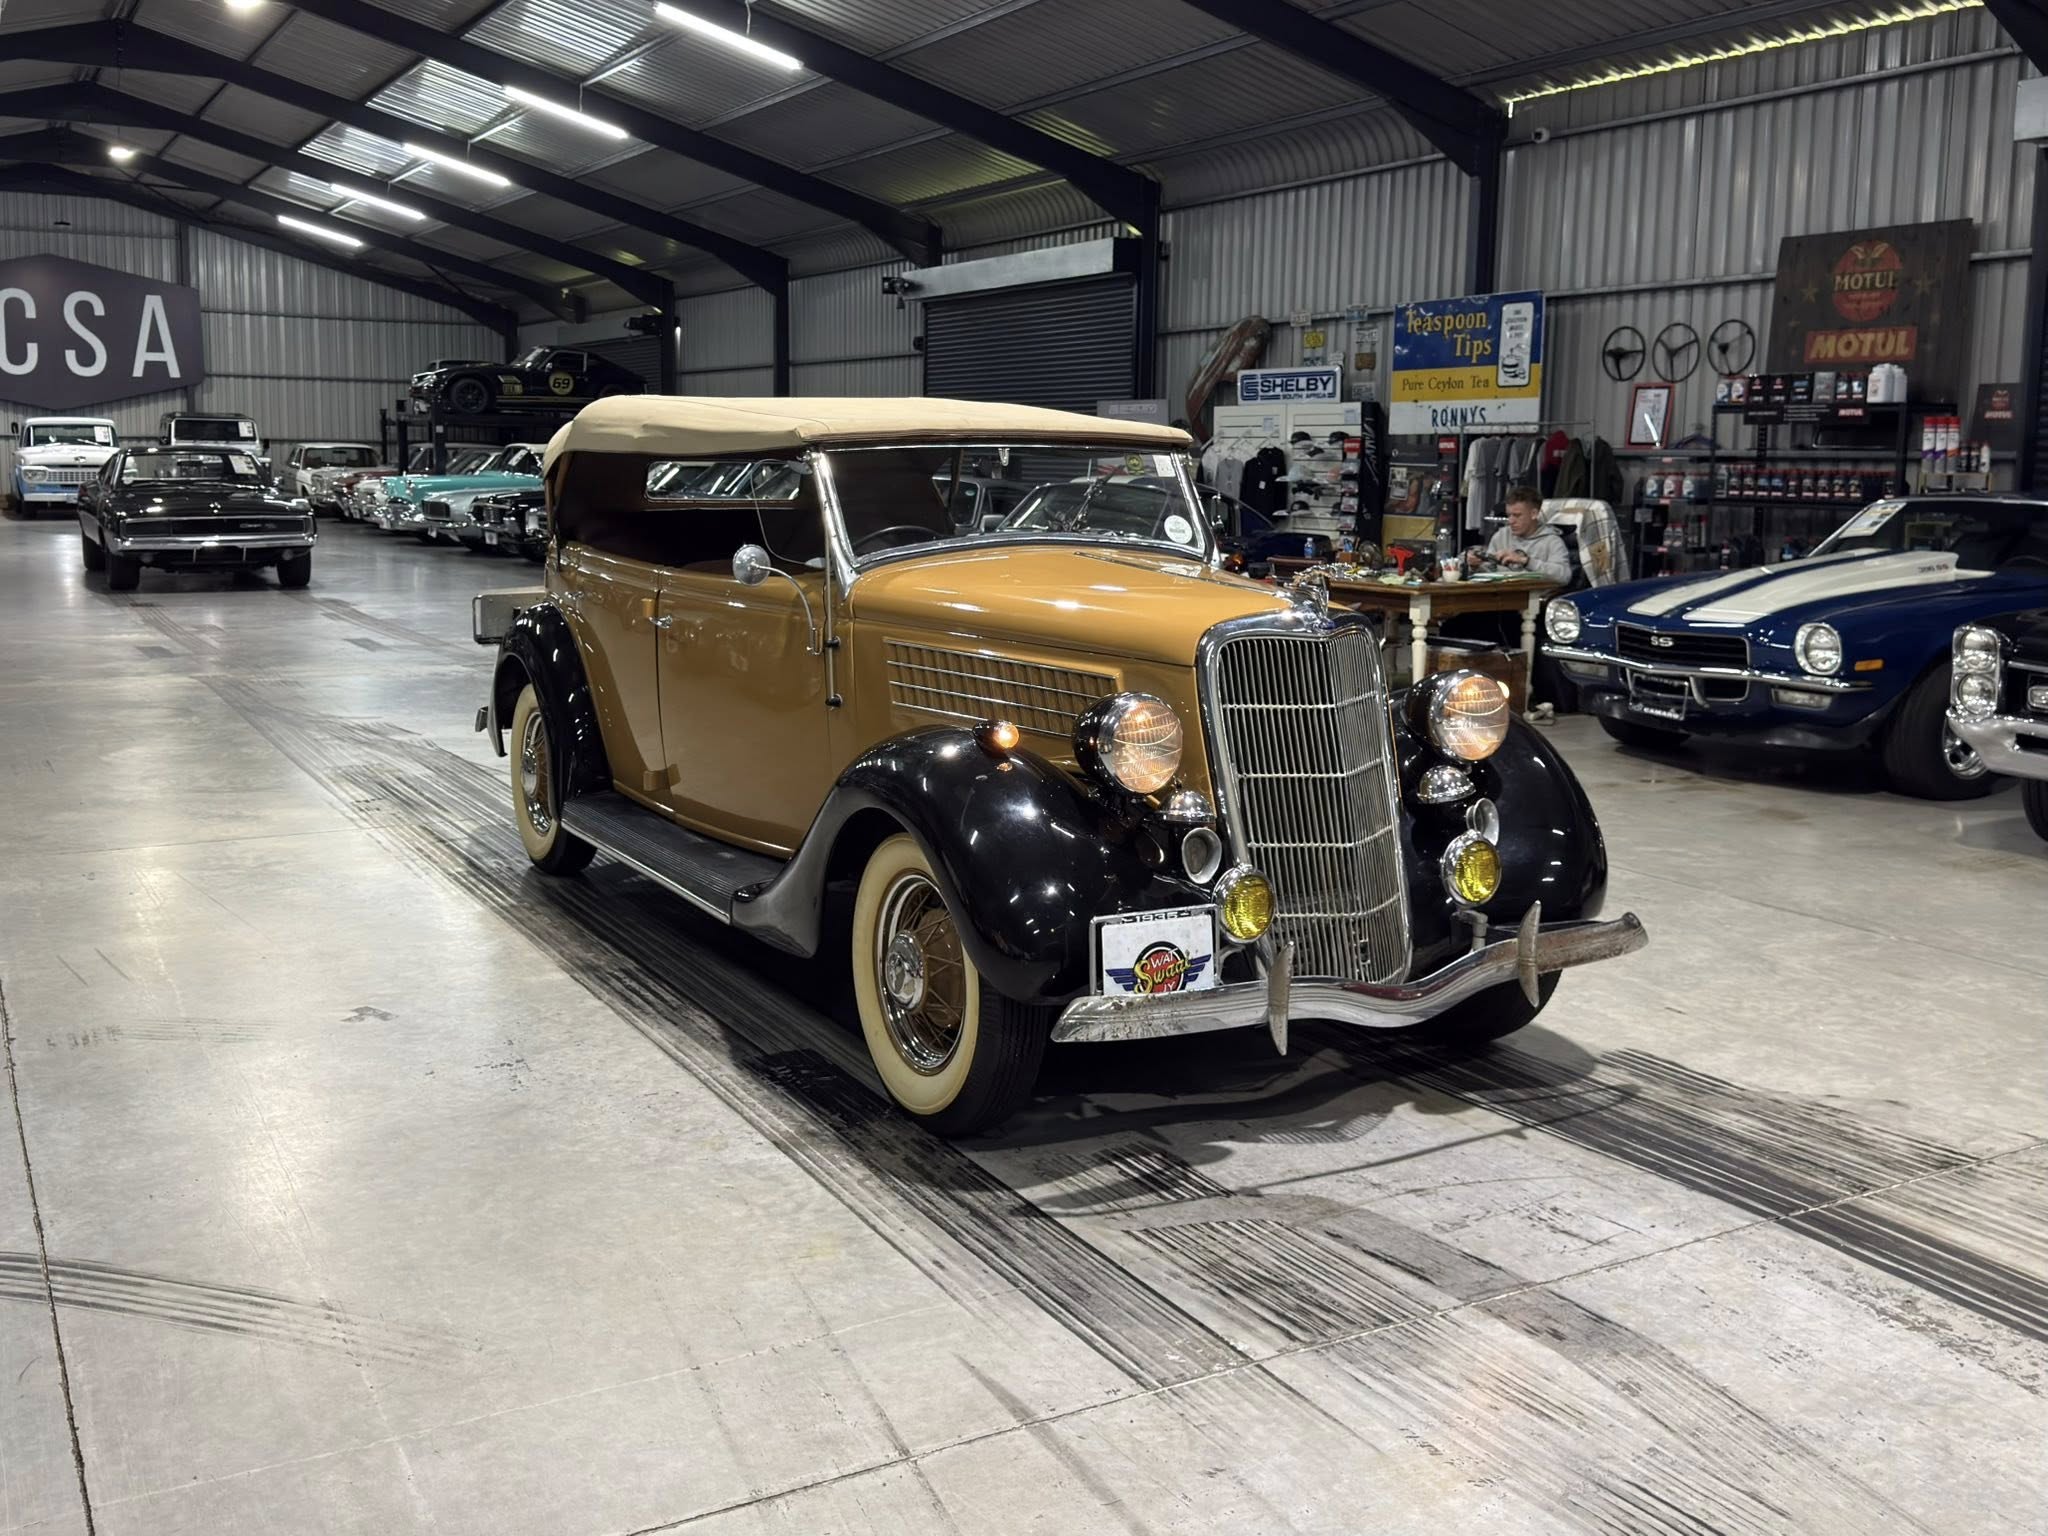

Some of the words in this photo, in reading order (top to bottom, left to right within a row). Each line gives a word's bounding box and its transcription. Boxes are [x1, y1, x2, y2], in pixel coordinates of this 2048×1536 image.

[1405, 309, 1488, 338] Teaspoon
[1453, 332, 1492, 363] Tips
[1809, 330, 1910, 359] MOTUL
[553, 378, 570, 389] 69
[1260, 377, 1332, 393] SHELBY
[1402, 378, 1424, 391] Pure
[1428, 376, 1464, 392] Ceylon
[1470, 375, 1489, 389] Tea
[1431, 407, 1487, 427] RONNYS
[1650, 635, 1675, 647] SS
[1150, 947, 1178, 968] WAT
